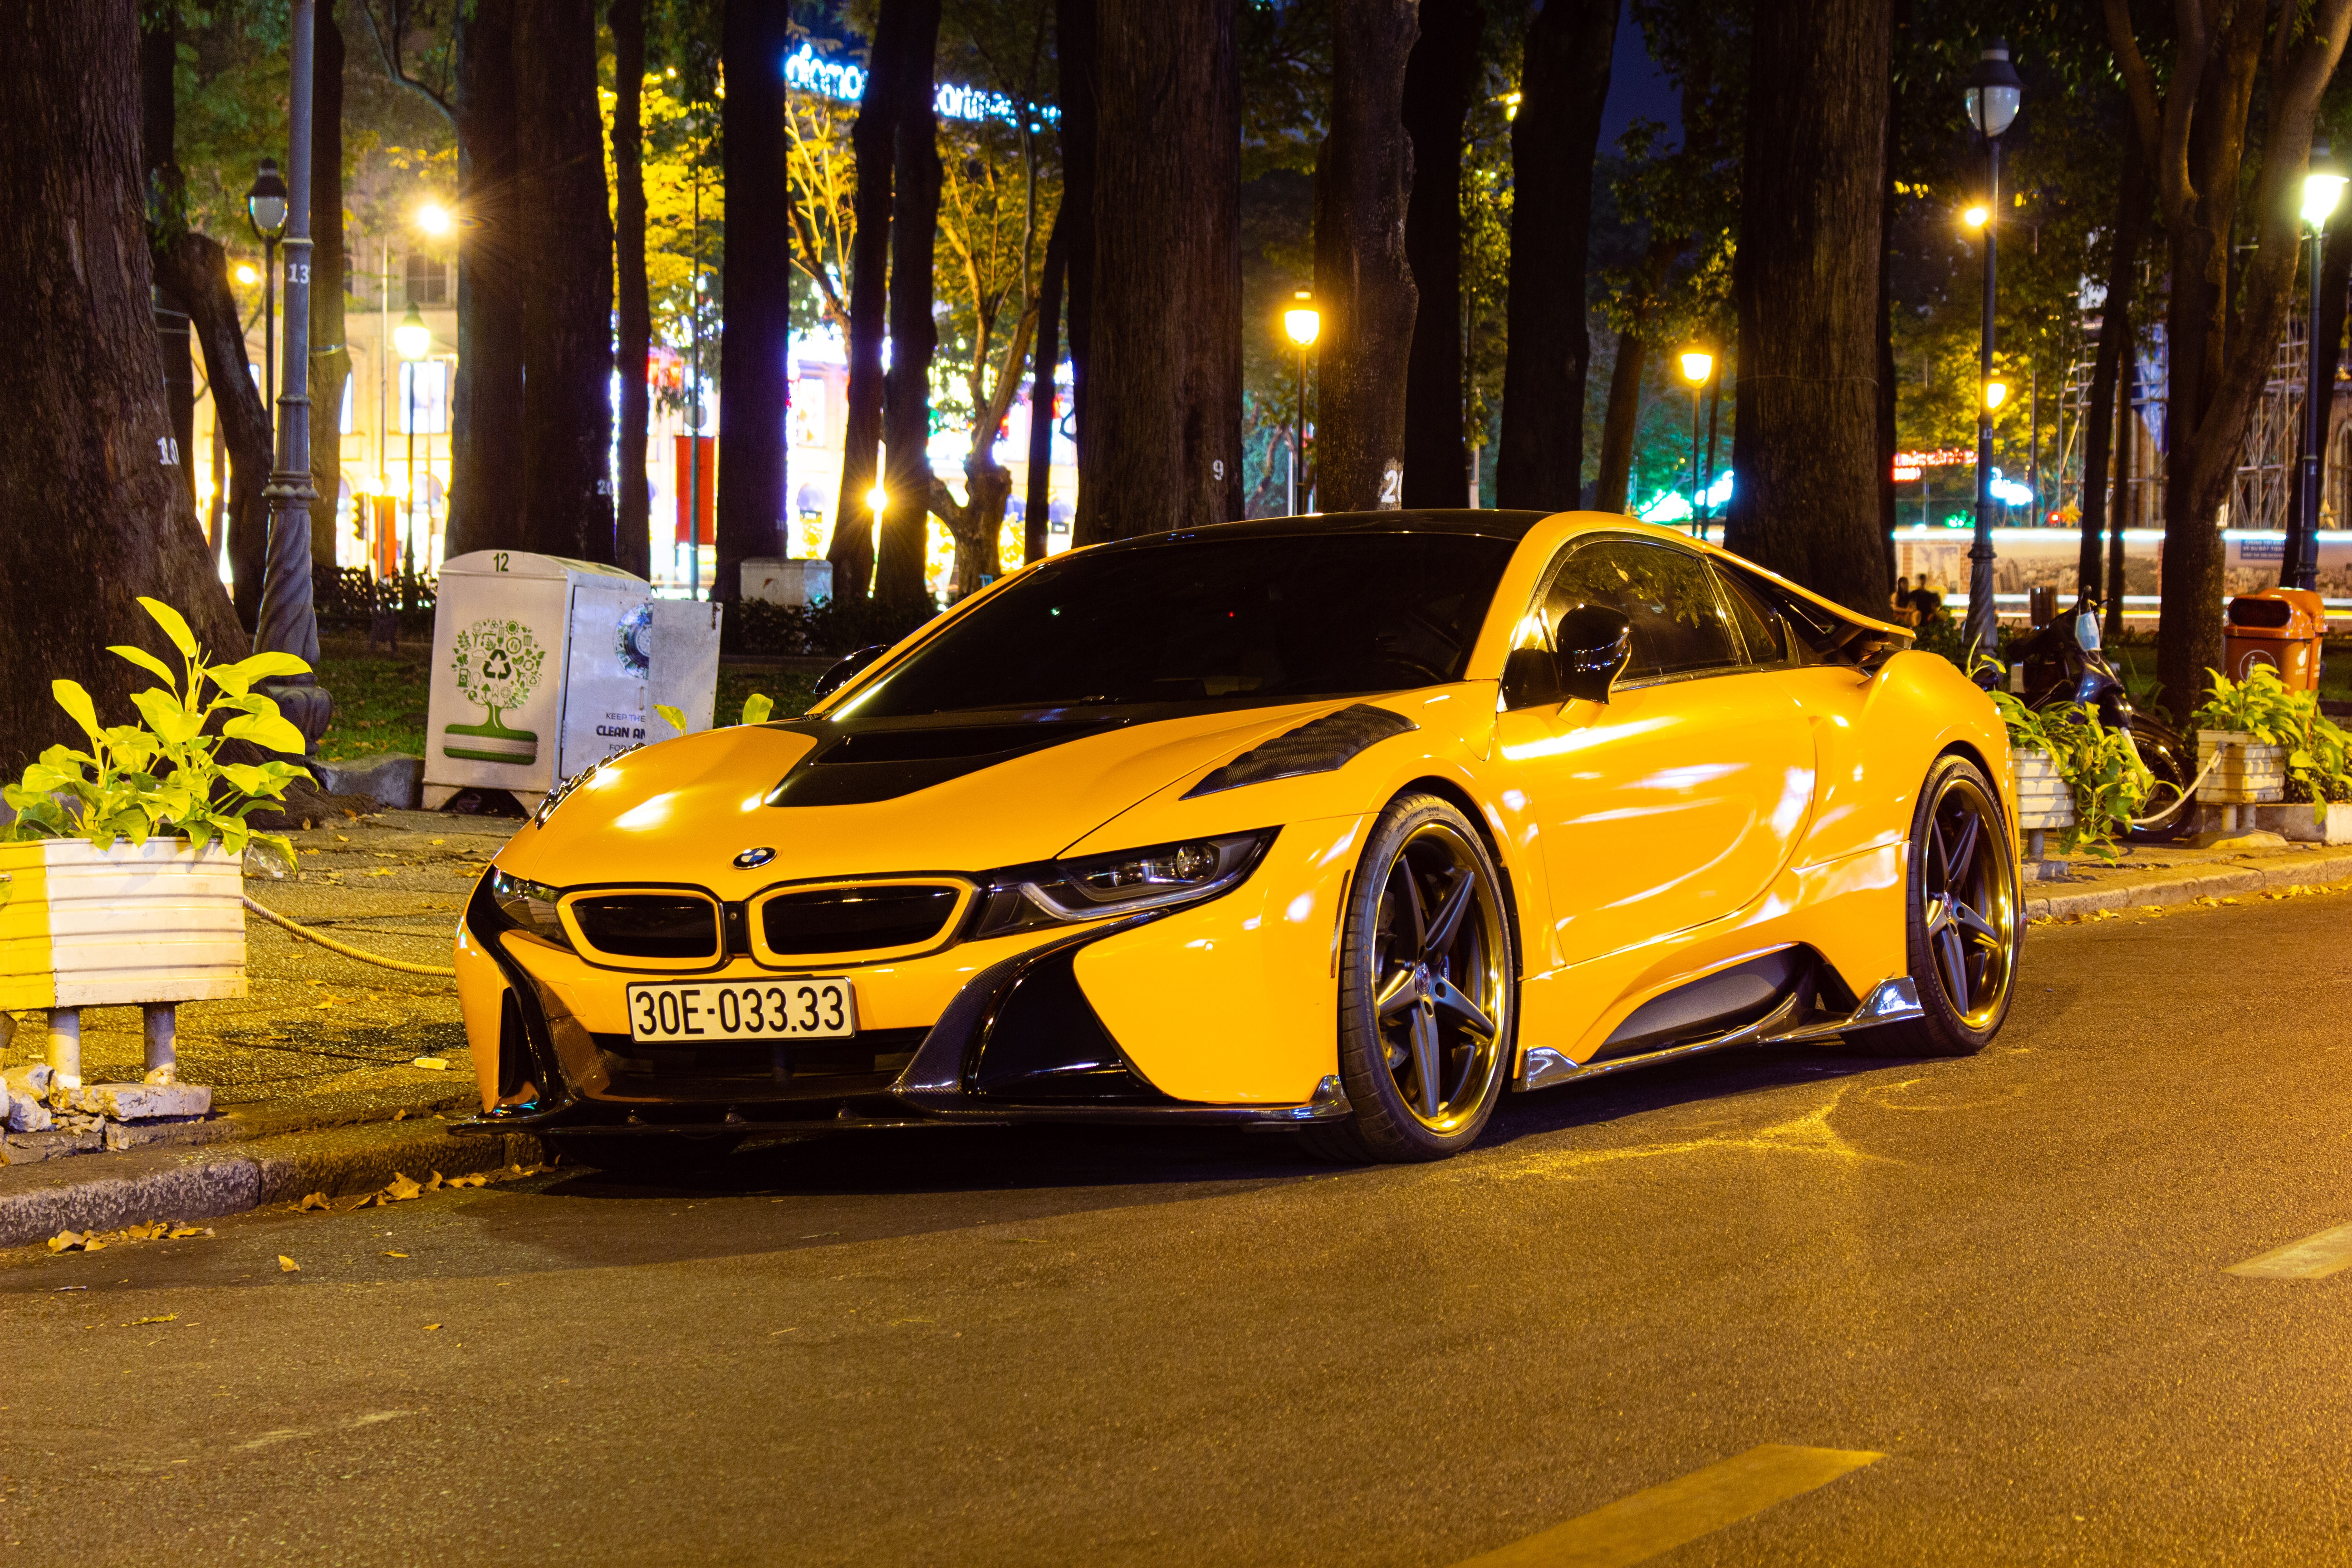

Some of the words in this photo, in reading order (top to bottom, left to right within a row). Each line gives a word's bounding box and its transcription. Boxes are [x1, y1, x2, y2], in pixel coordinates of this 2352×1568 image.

[288, 263, 309, 284] 13
[1213, 459, 1224, 480] 9
[494, 553, 509, 572] 12
[629, 714, 645, 722] THE
[596, 725, 630, 738] CLEAN
[635, 985, 845, 1035] 30E-033.33
